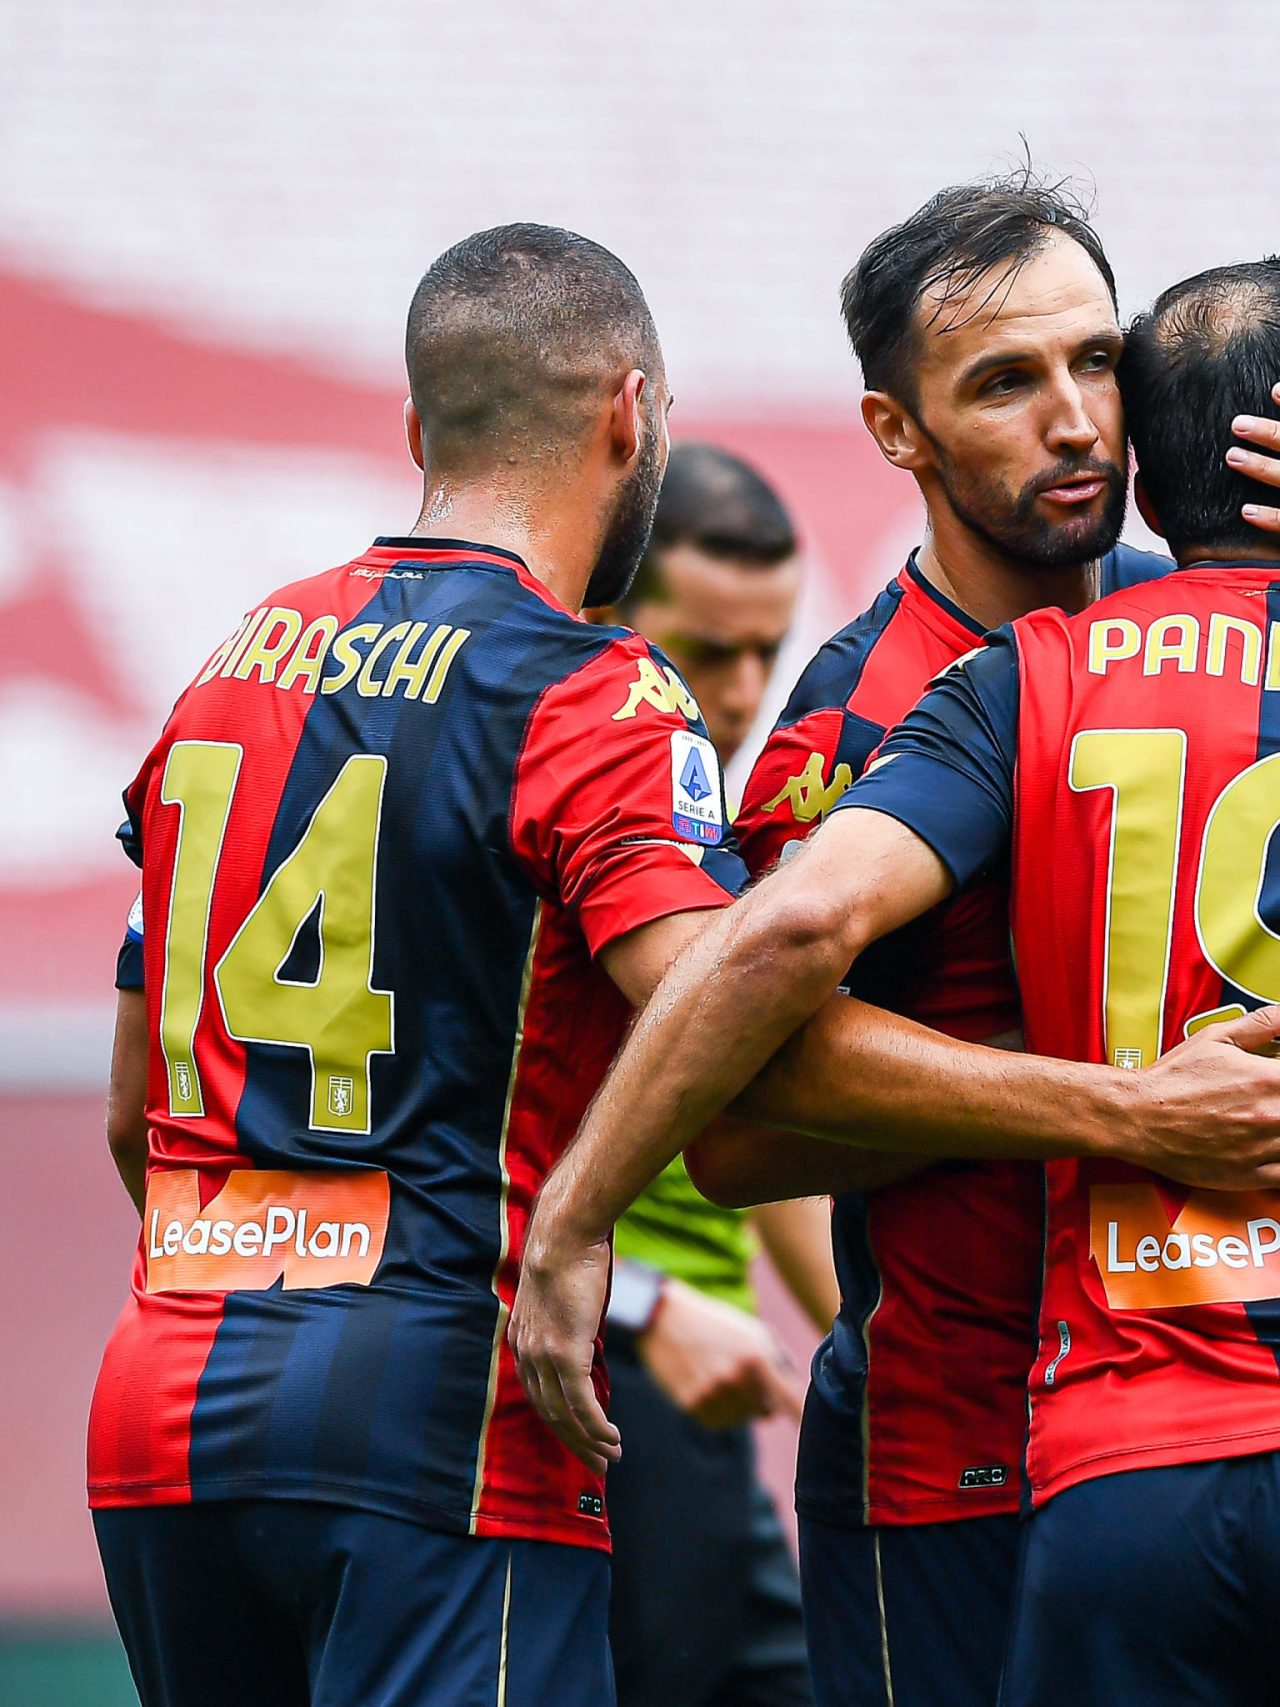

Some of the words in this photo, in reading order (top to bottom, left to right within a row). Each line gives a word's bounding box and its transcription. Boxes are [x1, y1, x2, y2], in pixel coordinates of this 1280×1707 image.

[678, 800, 705, 817] SERIE
[707, 809, 716, 820] A
[160, 739, 396, 1136] 14
[149, 1206, 372, 1259] LeasePlan
